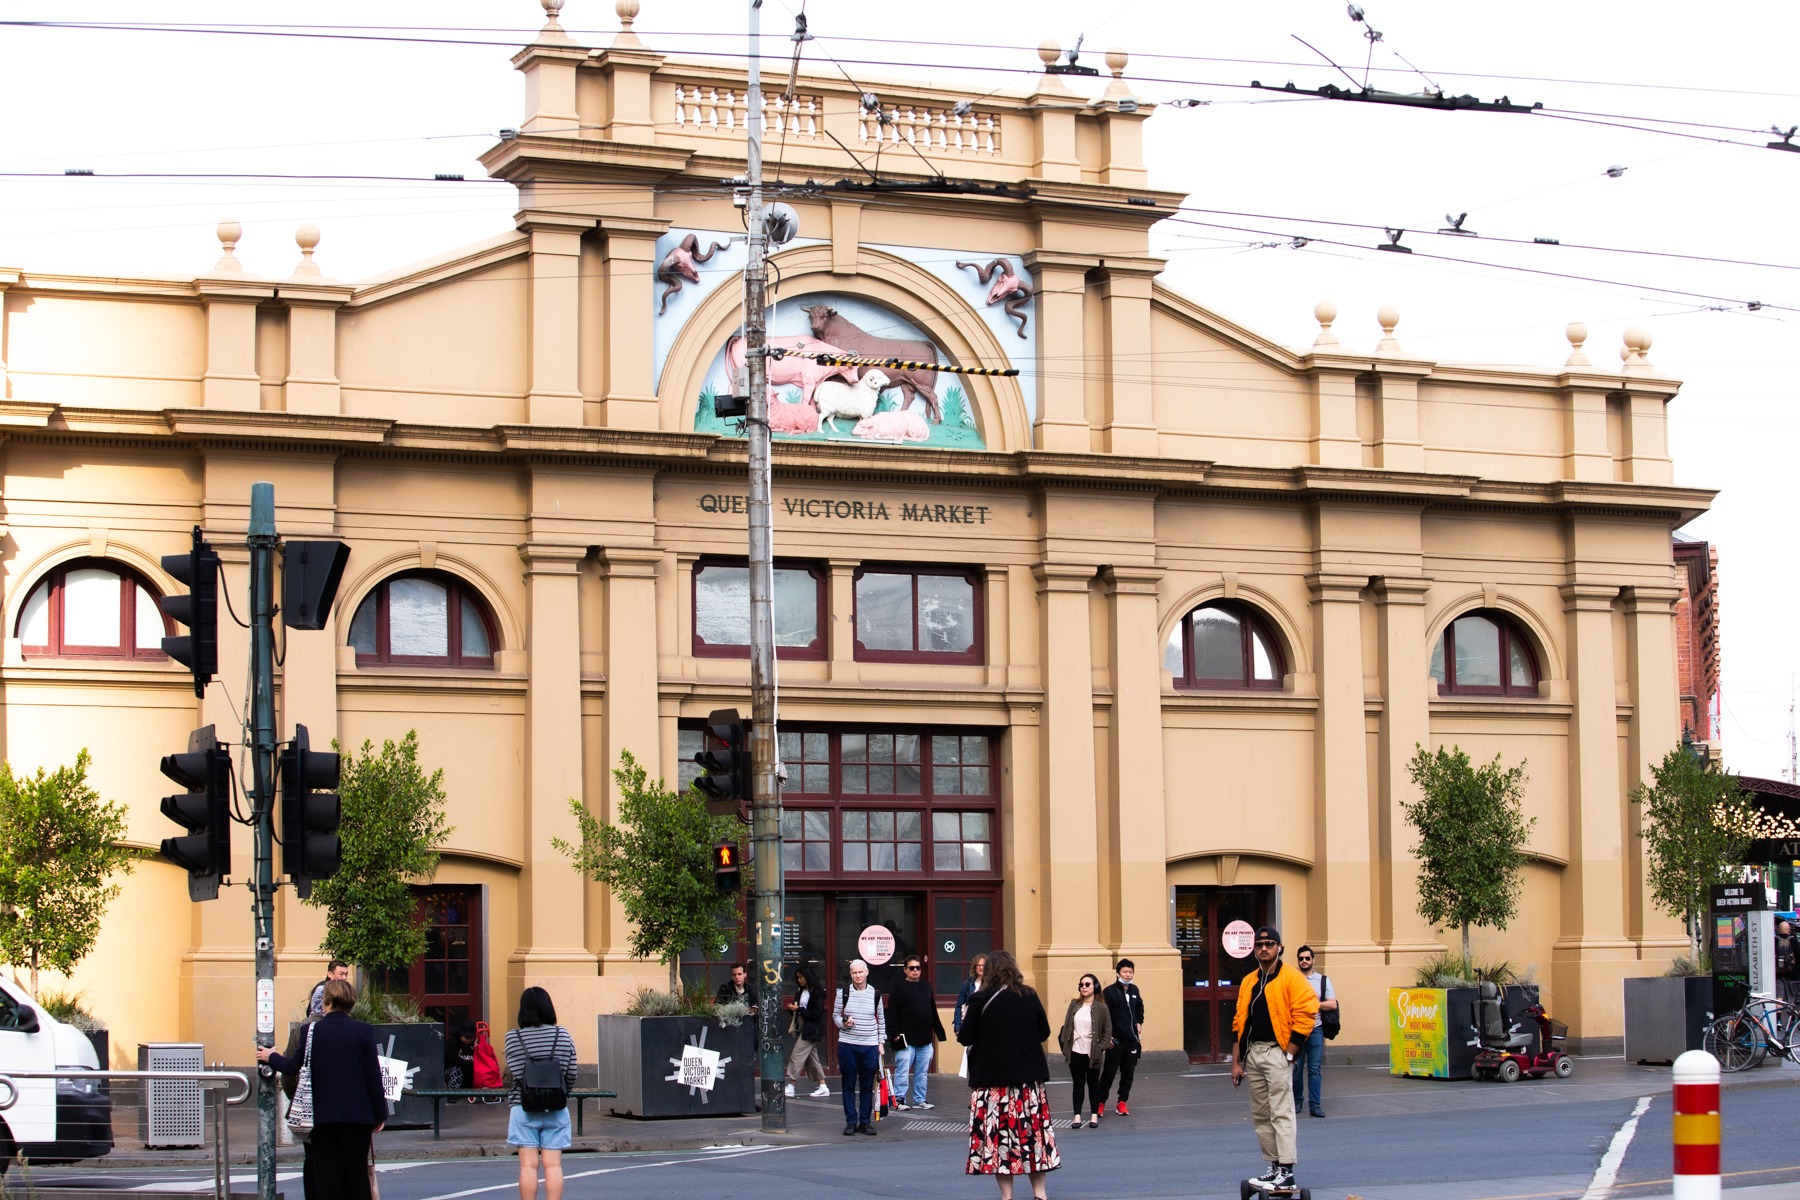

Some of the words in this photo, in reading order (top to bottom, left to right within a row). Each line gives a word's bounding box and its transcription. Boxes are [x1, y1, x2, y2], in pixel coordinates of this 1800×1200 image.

[783, 498, 890, 520] VICTORIA
[902, 503, 989, 524] MARKET
[1724, 888, 1739, 896] WELCOME
[1752, 921, 1757, 932] ST
[1397, 991, 1438, 1028] Summer
[1410, 1022, 1421, 1030] NIGHT
[1422, 1022, 1436, 1030] MARKET
[683, 1057, 703, 1067] QUEEN
[683, 1066, 711, 1076] VICTORIA
[683, 1076, 708, 1085] MARKET
